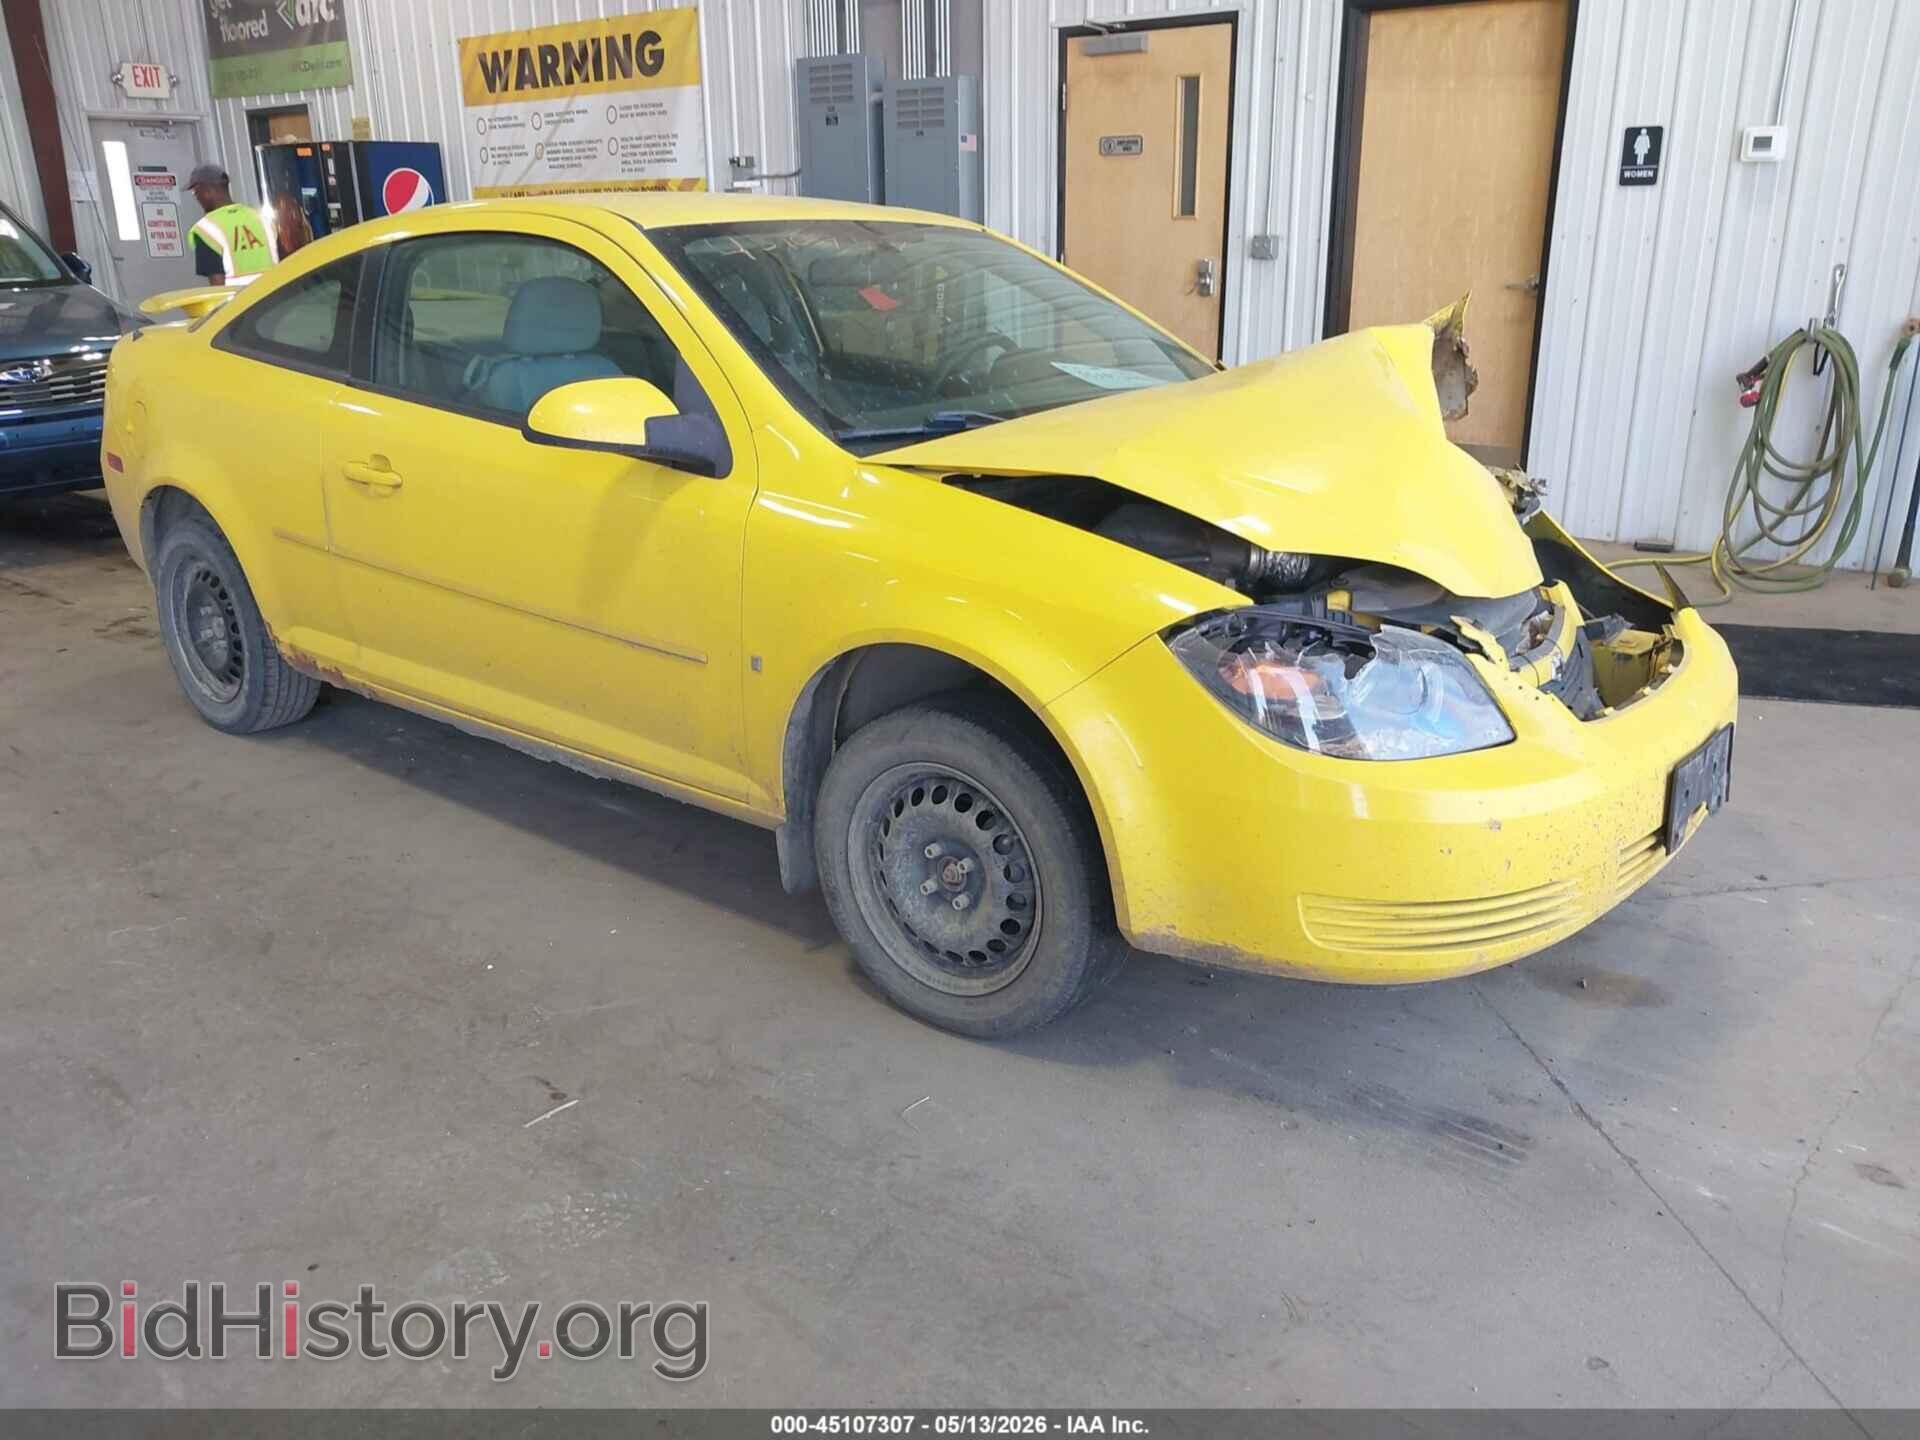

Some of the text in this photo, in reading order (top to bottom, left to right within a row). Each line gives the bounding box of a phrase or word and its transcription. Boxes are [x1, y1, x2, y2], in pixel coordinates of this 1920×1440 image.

[220, 8, 270, 42] floored
[478, 30, 665, 94] WARNING
[132, 65, 161, 88] EXIT
[1623, 170, 1654, 179] WOMEN
